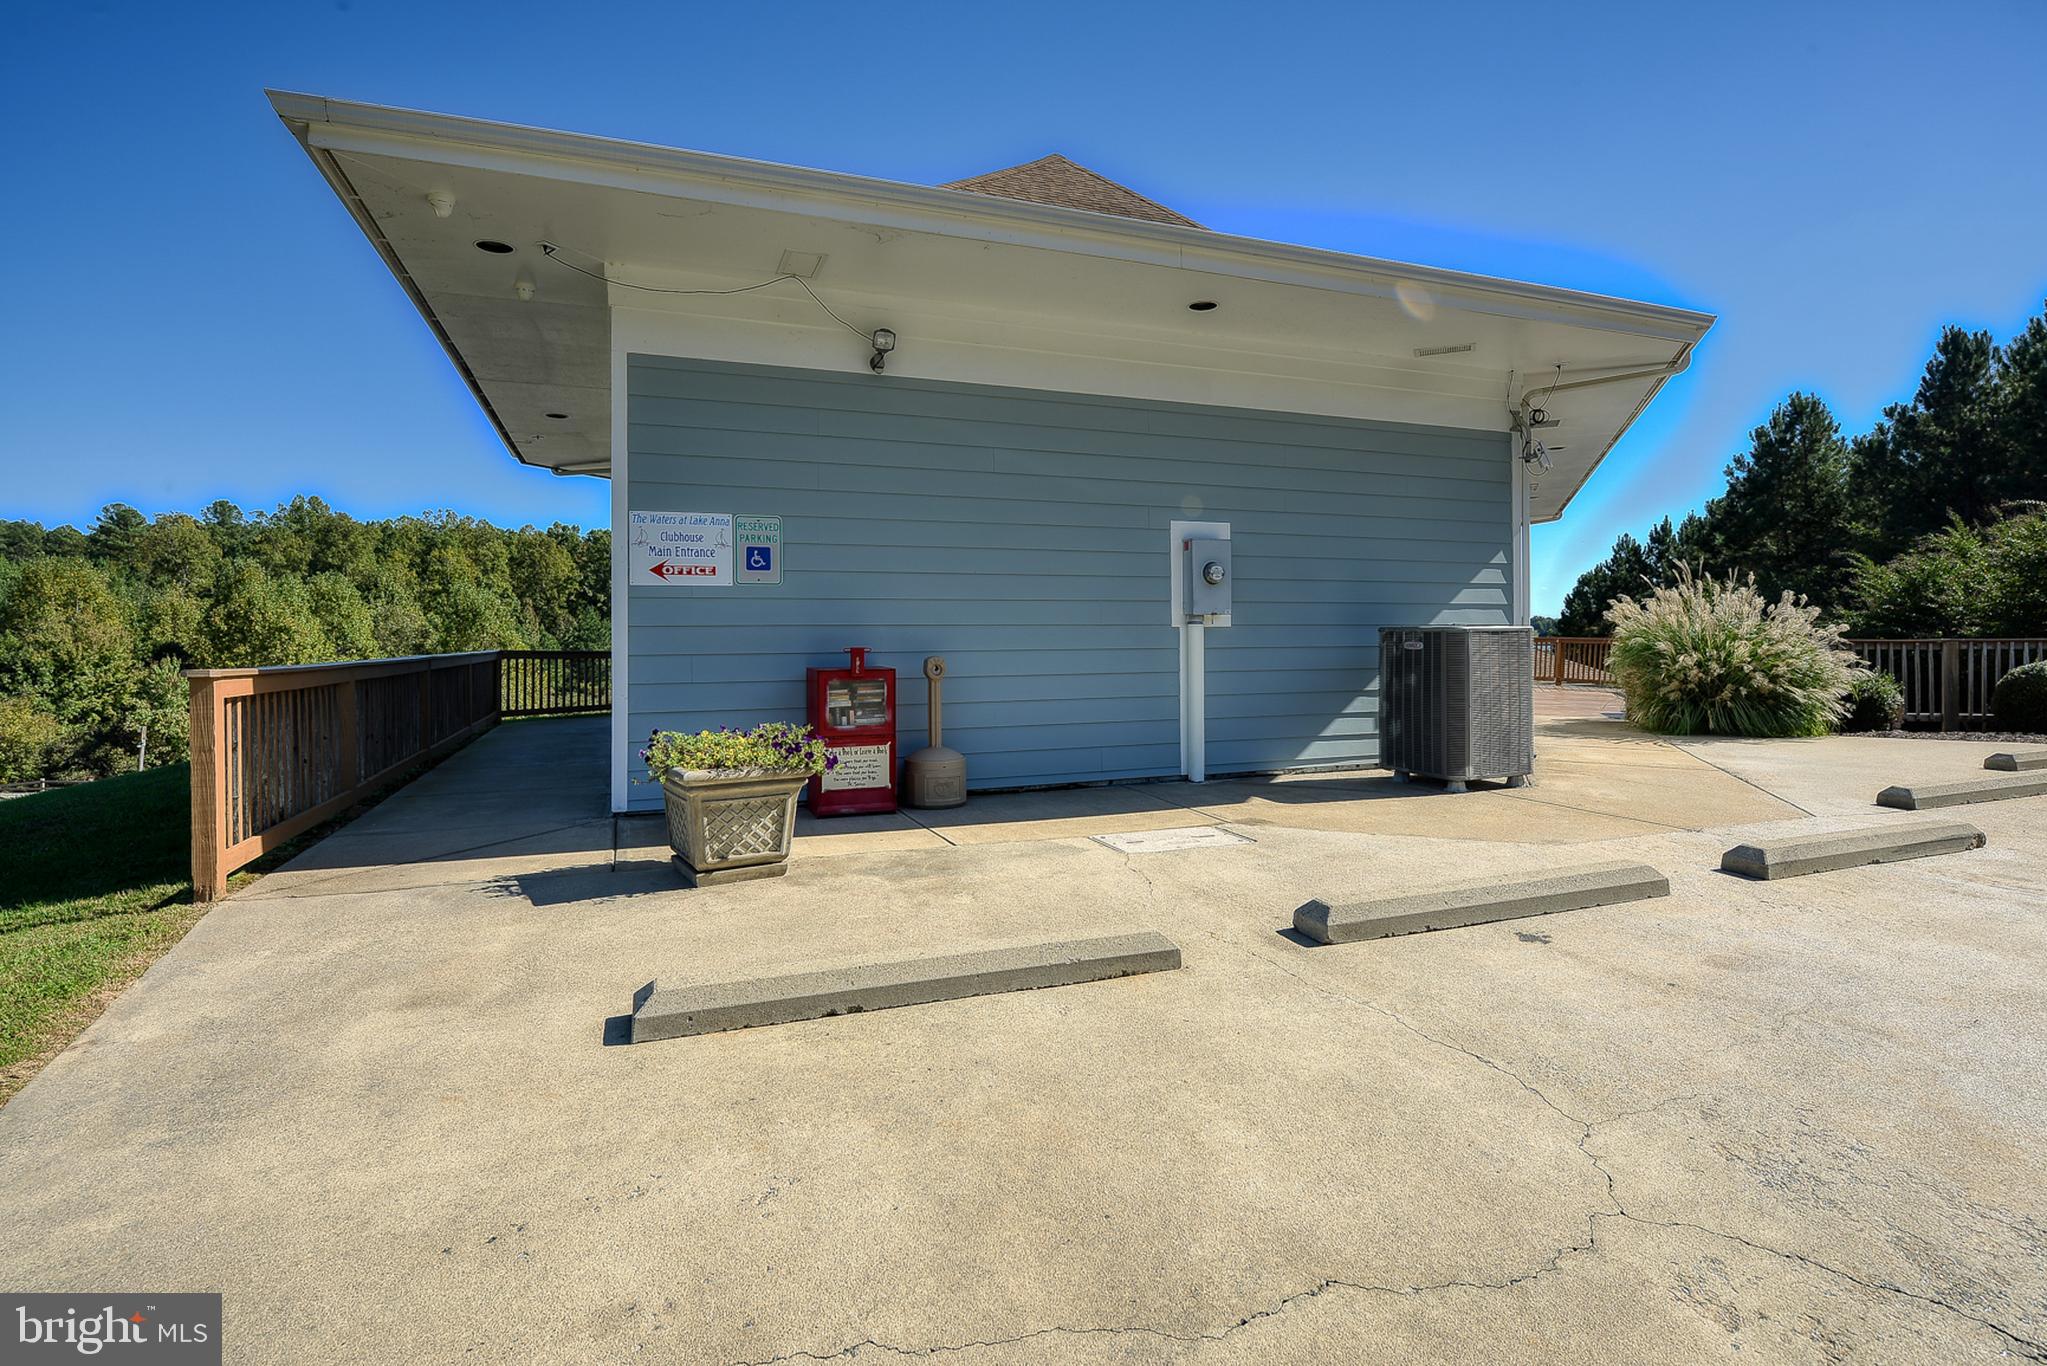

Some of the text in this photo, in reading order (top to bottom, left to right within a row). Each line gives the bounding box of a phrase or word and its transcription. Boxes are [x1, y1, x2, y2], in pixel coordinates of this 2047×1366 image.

[632, 513, 730, 526] The Waters at Lake Anna
[737, 521, 779, 532] RESERVED
[660, 531, 704, 543] Clubhouse
[739, 534, 778, 544] PARKING
[648, 546, 716, 558] Main Entrance
[662, 565, 714, 576] OFFICE
